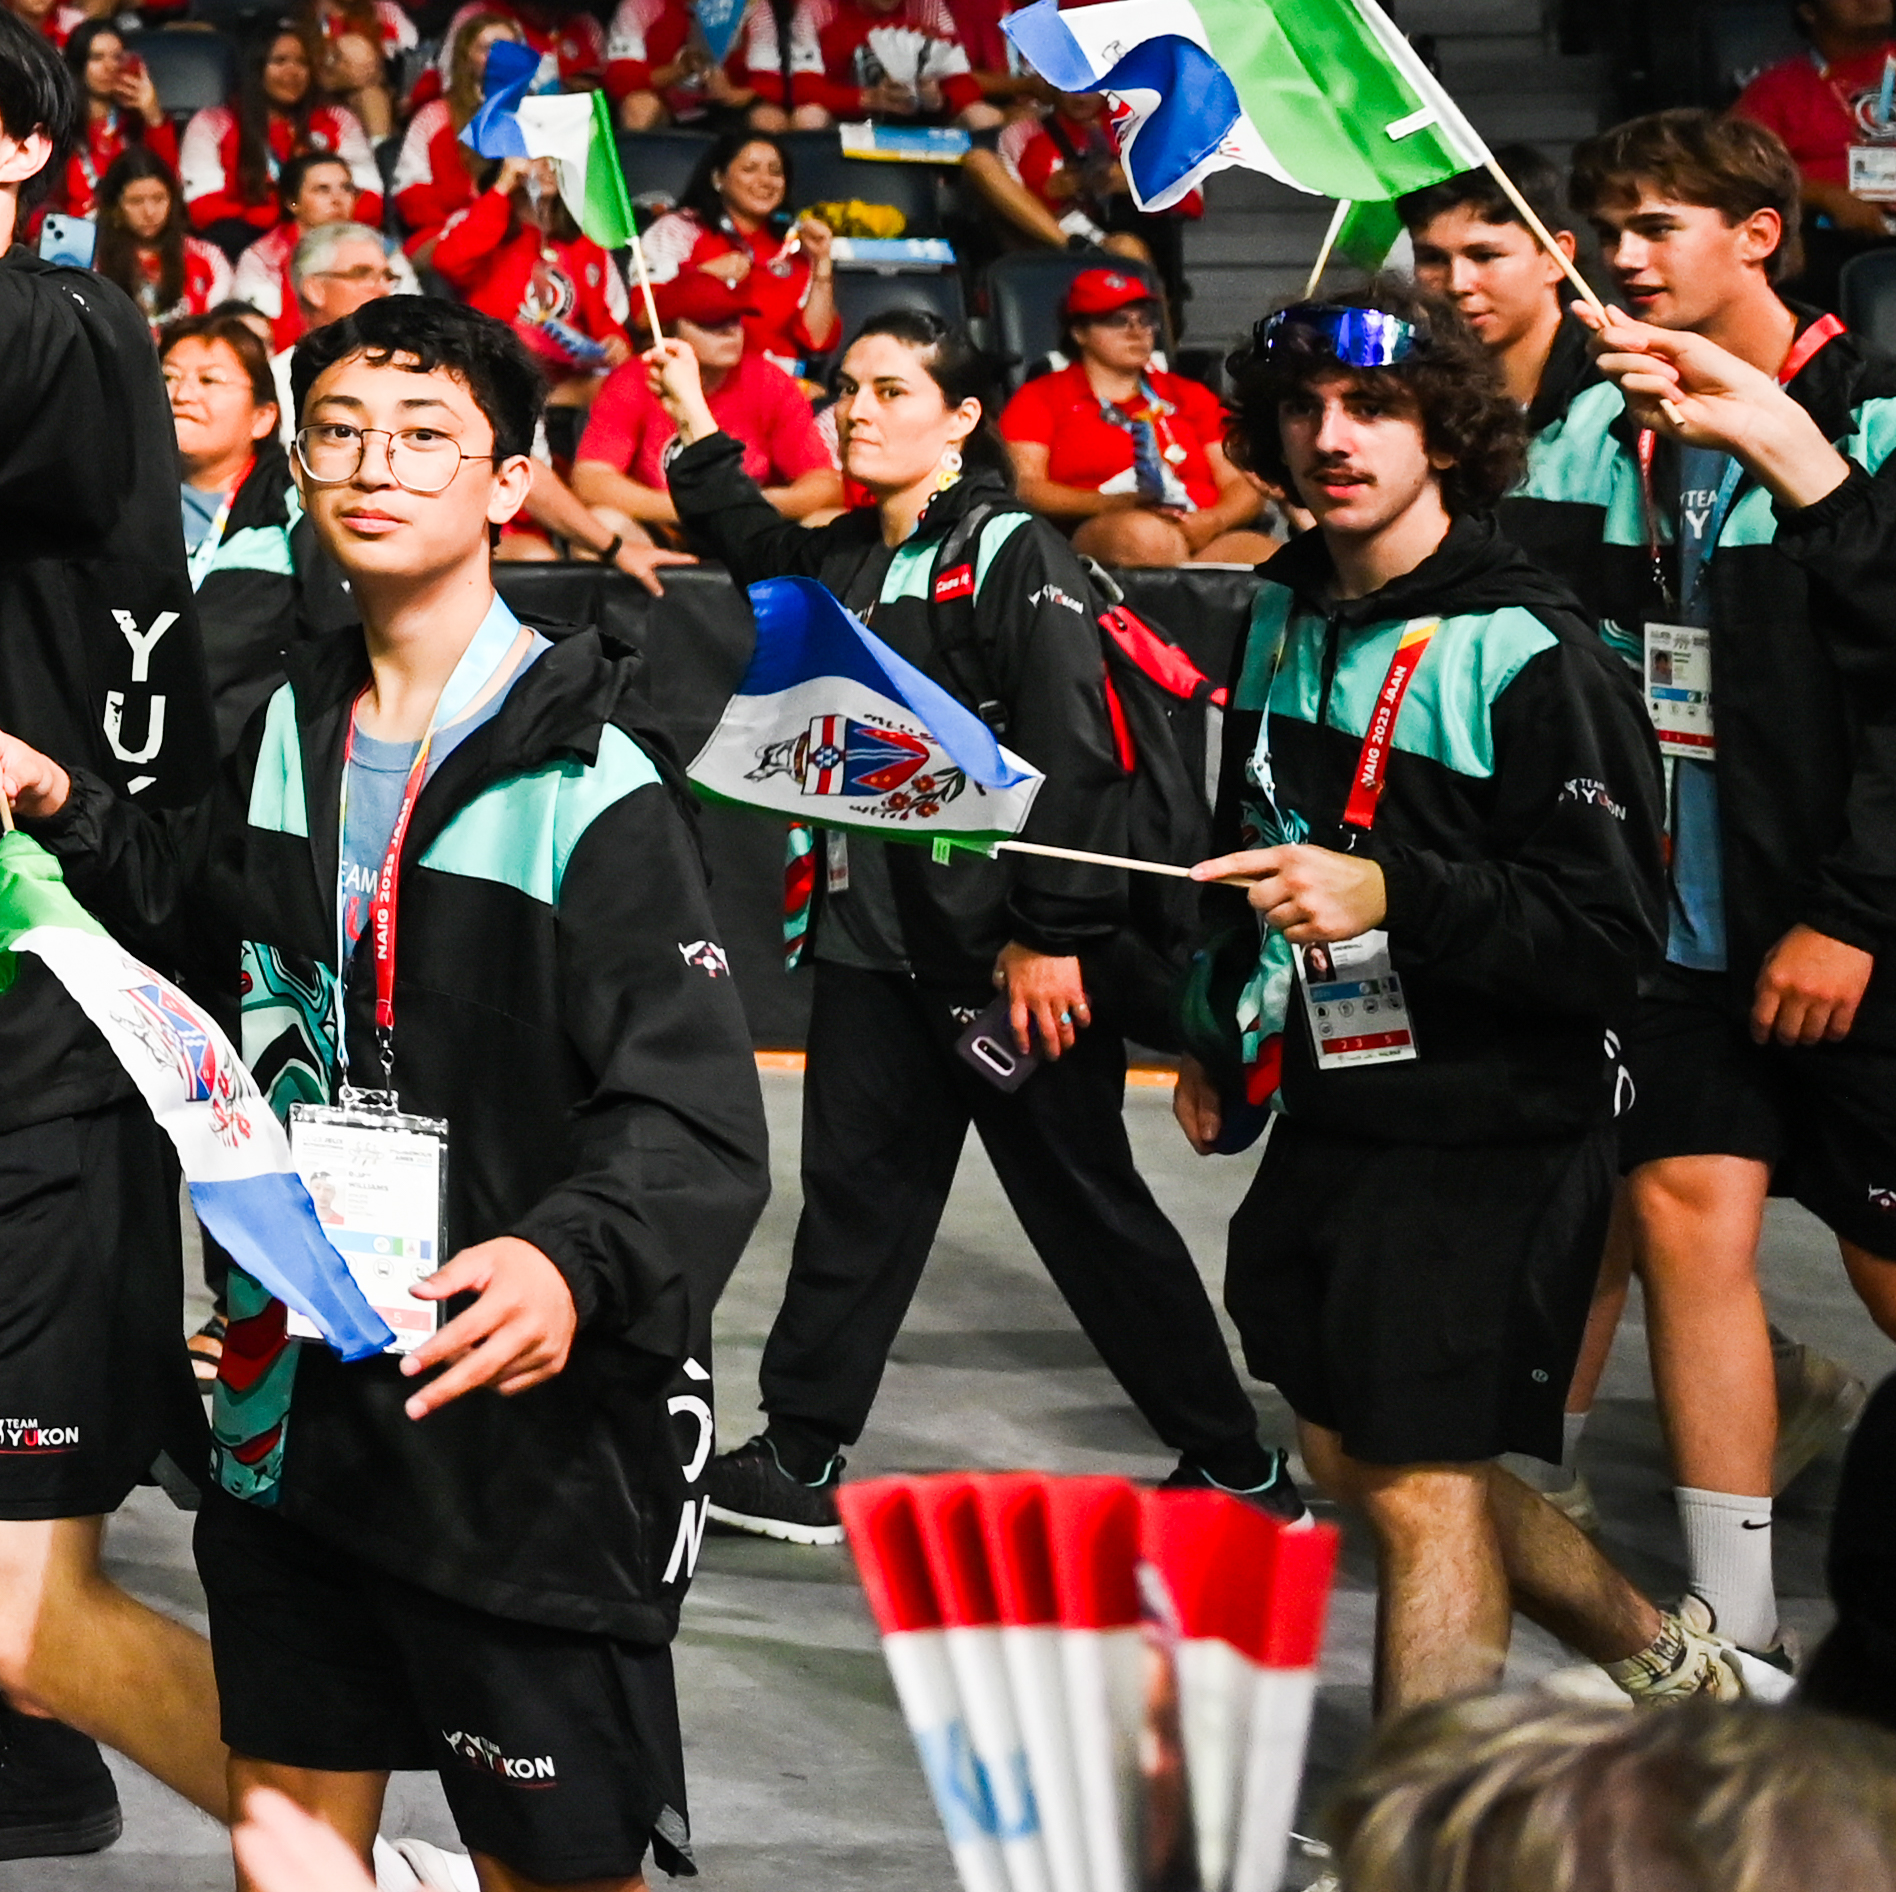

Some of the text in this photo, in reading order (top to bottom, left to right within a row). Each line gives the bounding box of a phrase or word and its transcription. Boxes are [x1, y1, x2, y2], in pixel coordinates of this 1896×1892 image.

[1371, 706, 1391, 746] 2023
[1383, 665, 1408, 705] JAAN
[379, 853, 396, 903] 2023
[376, 908, 390, 960] NAIG
[5, 1417, 39, 1429] TEAM
[6, 1426, 79, 1447] YUKON
